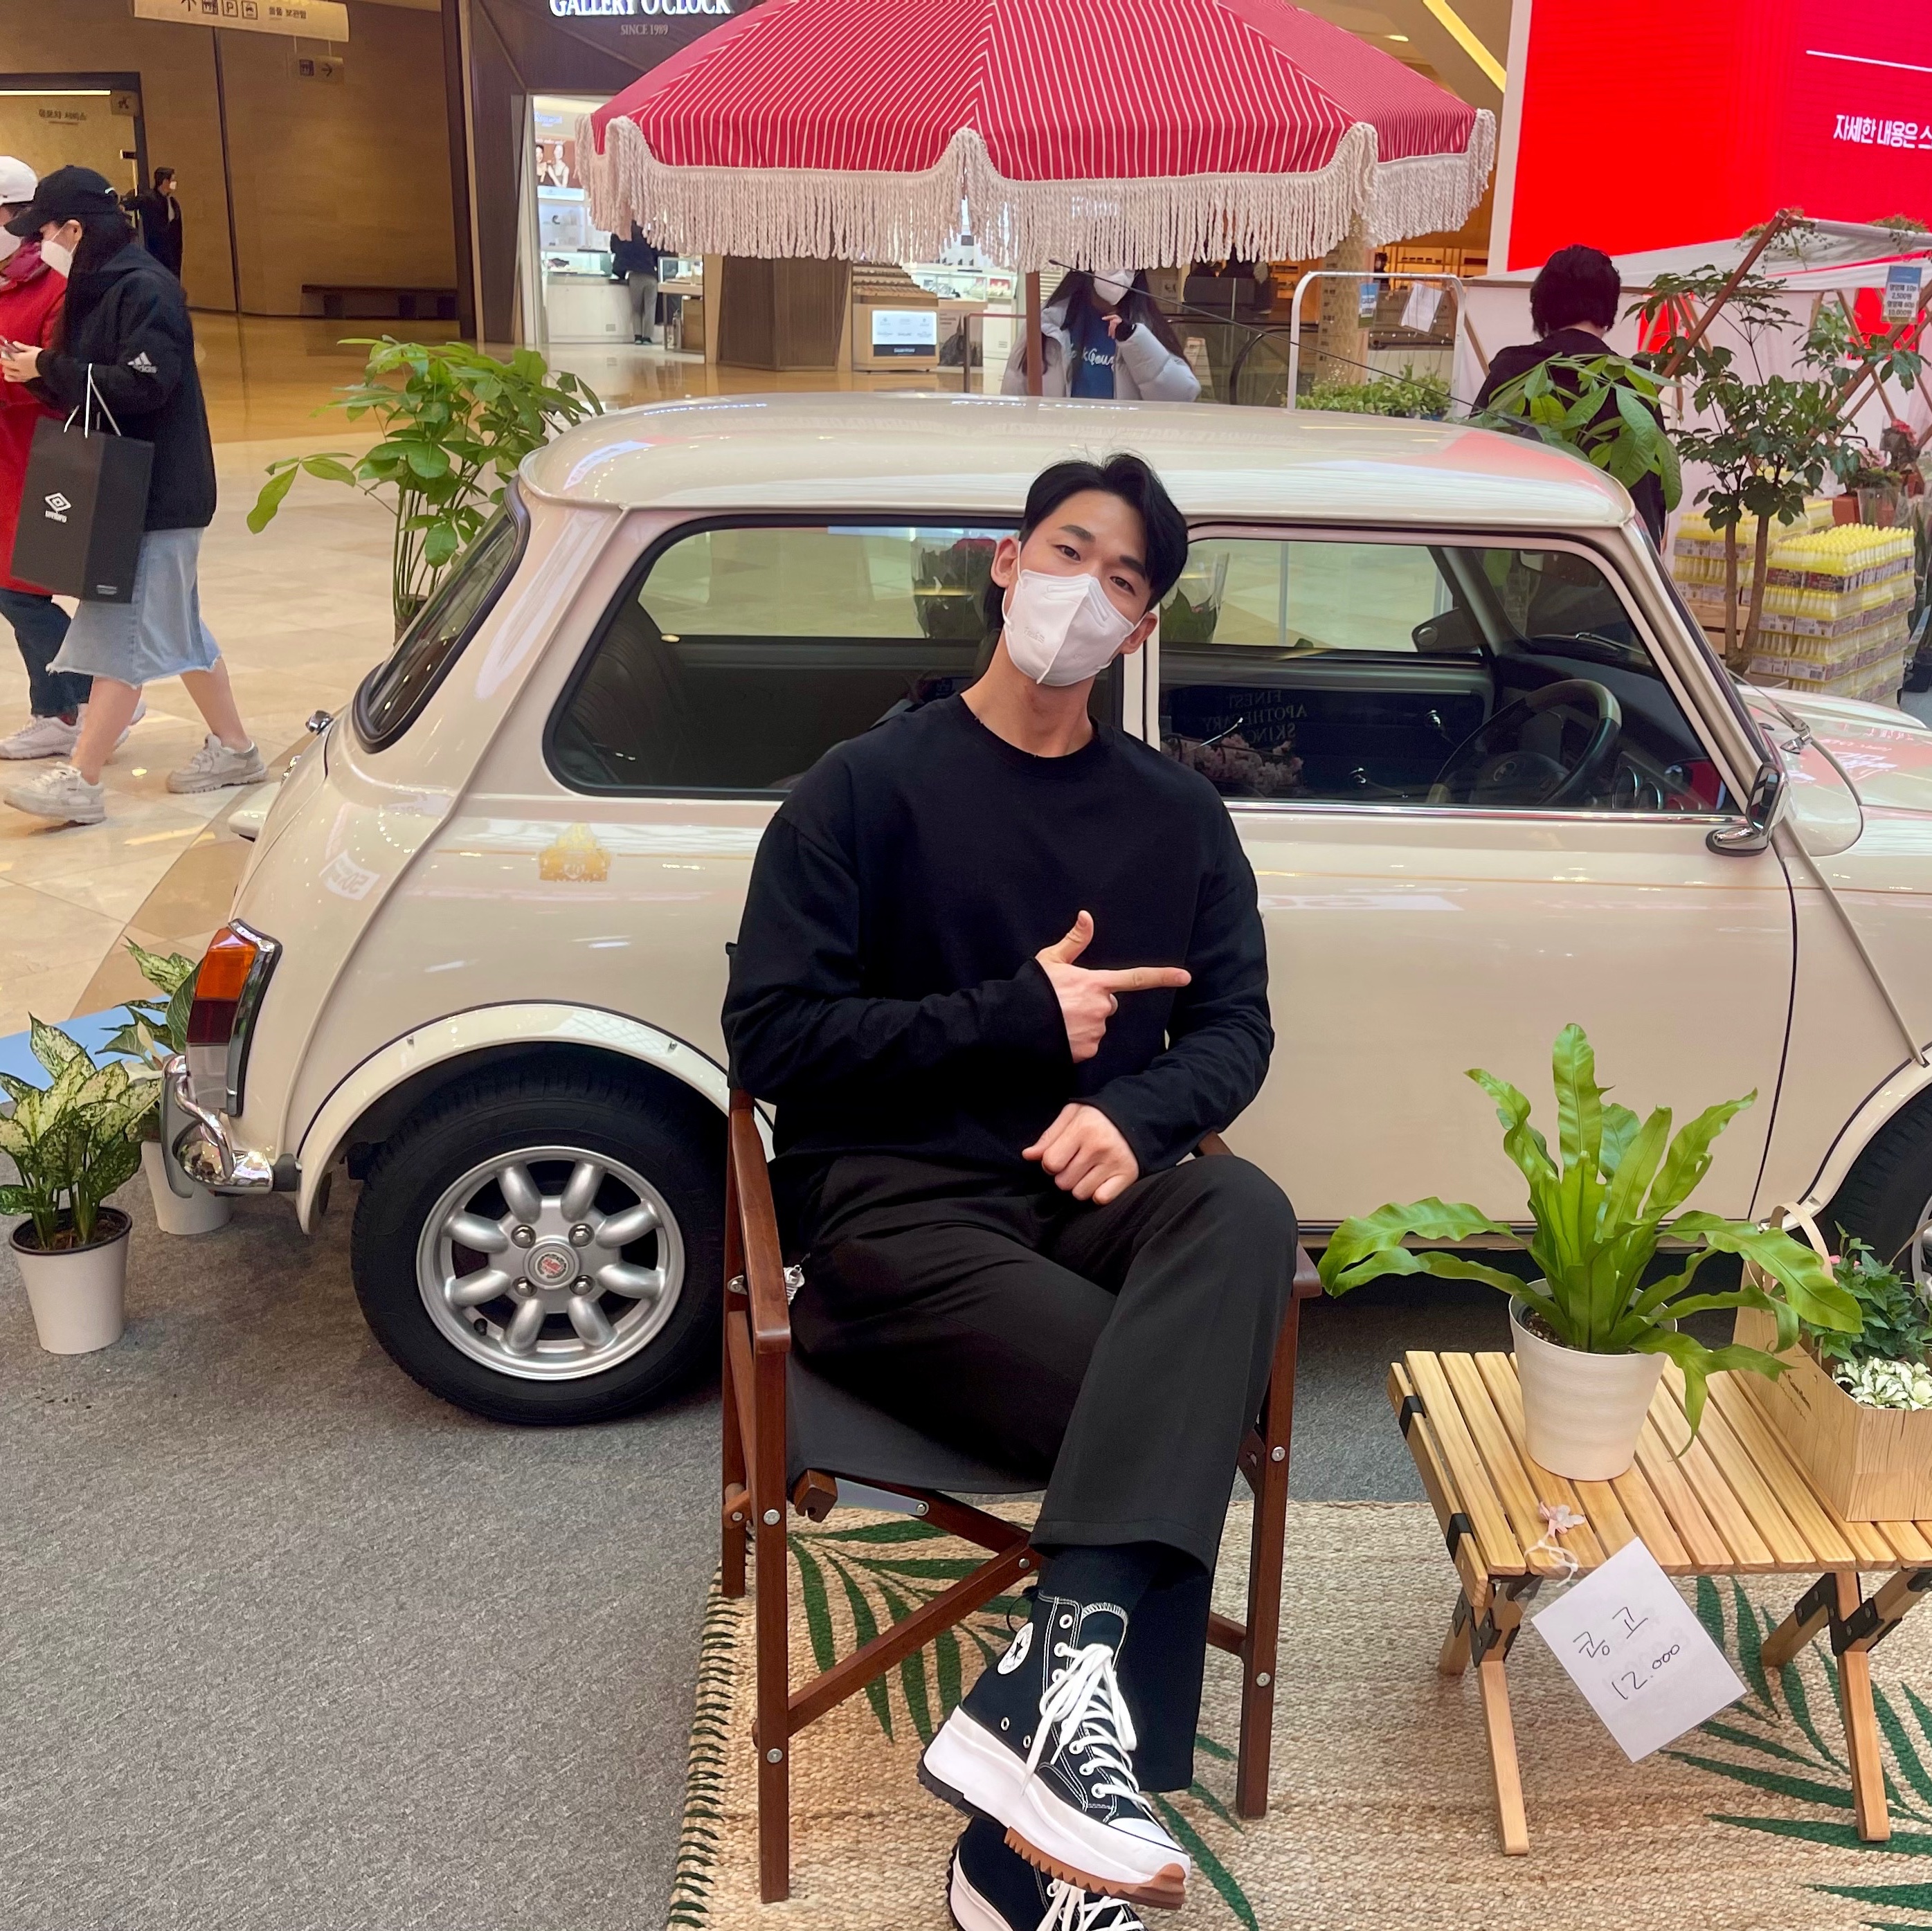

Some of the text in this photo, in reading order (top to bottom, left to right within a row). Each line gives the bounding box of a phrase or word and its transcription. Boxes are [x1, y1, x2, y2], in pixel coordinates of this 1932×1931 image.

[620, 24, 669, 35] SINCE 1989
[1833, 114, 1877, 144] 자세한
[1877, 120, 1918, 149] 내용은
